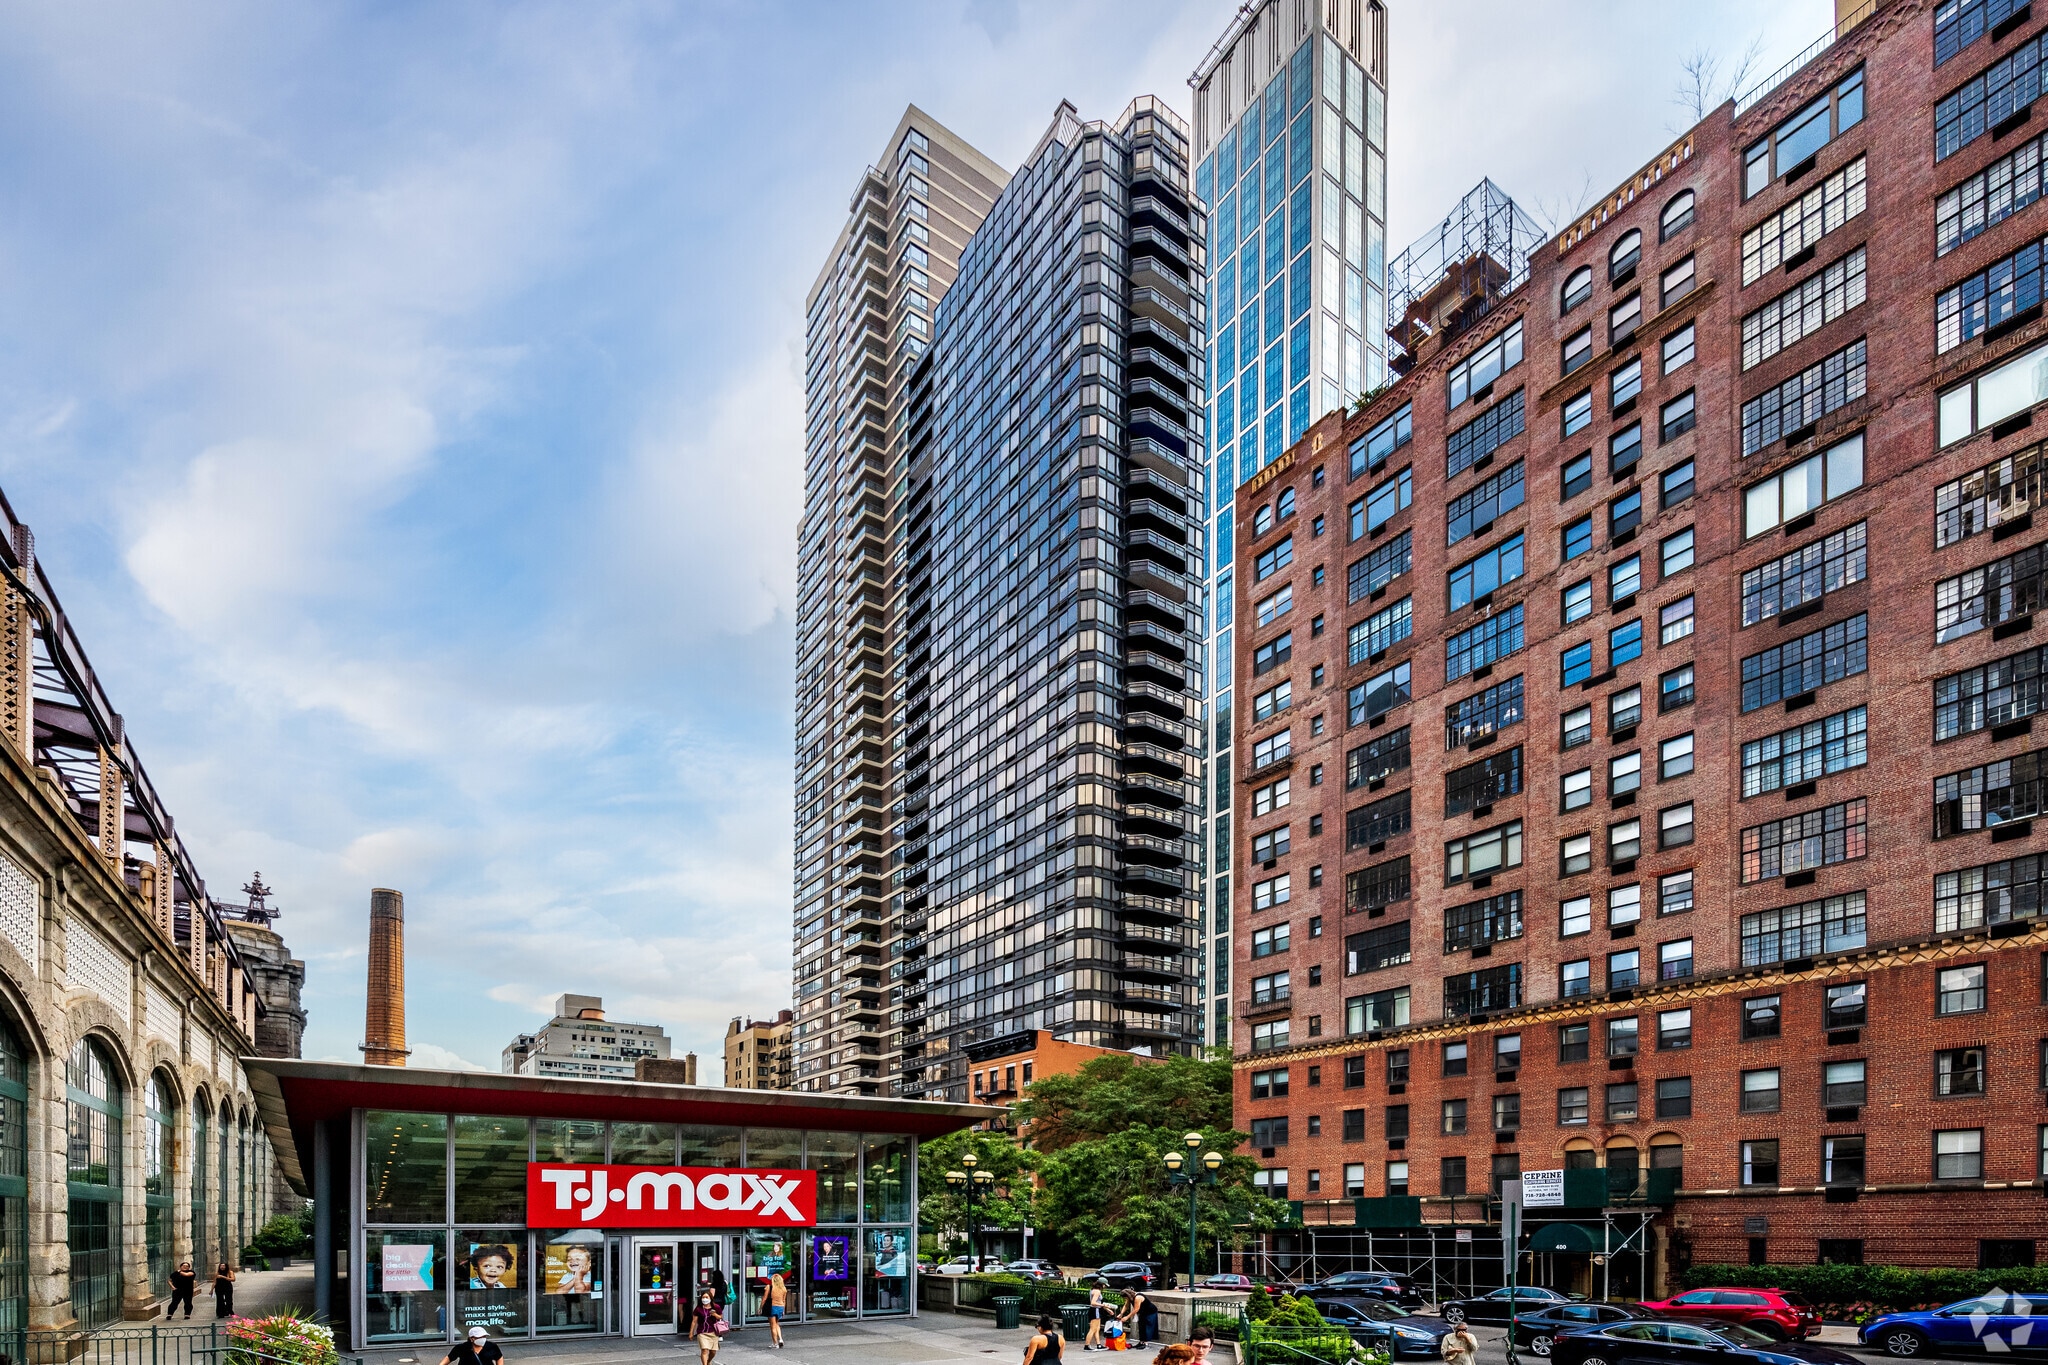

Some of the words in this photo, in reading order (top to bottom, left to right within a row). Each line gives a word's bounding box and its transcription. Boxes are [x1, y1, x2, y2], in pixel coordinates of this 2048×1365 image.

[1524, 1171, 1562, 1180] CEPRINE
[385, 1253, 401, 1262] big
[385, 1261, 412, 1269] deals
